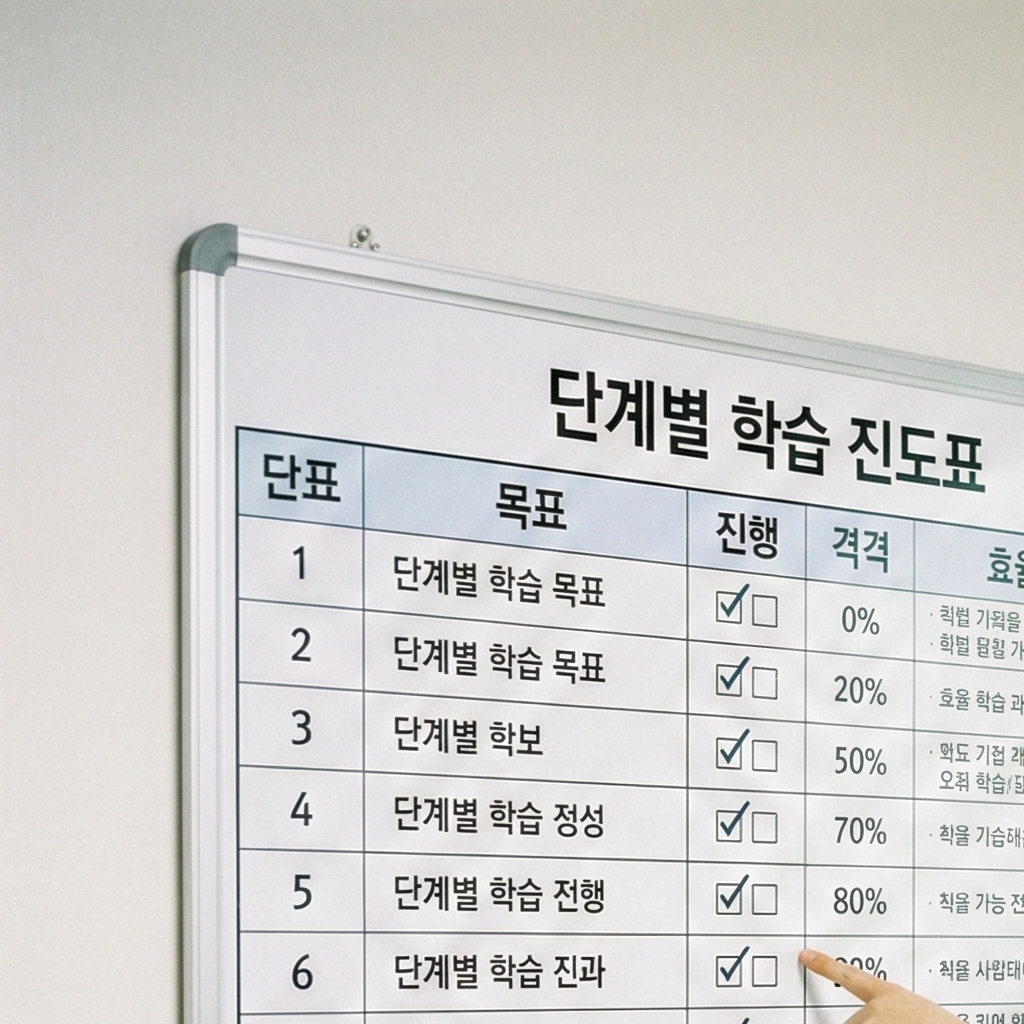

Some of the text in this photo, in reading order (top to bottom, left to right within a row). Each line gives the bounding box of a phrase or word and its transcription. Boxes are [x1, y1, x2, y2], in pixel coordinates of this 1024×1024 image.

[550, 367, 986, 493] 단계별 학습 진도표
[263, 453, 341, 503] 단표
[495, 482, 568, 531] 목표
[715, 512, 778, 560] 진행
[832, 526, 889, 574] 격격
[292, 545, 305, 580] 1
[393, 555, 606, 609] 단계별 학습 목표
[842, 606, 879, 635] 0%
[291, 627, 312, 663] 2
[394, 636, 606, 685] 단계별 학습 목표
[834, 674, 888, 706] 20%
[977, 690, 1005, 713] 학습
[291, 709, 312, 746] 3
[394, 716, 544, 757] 단계별 학보
[835, 747, 887, 775] 50%
[290, 791, 313, 827] 4
[394, 795, 604, 839] 단계별 학습 정성
[835, 817, 886, 844] 70%
[293, 873, 312, 910] 5
[394, 874, 605, 914] 단계별 학습 전행
[834, 887, 887, 914] 80%
[976, 894, 1006, 915] 가능
[291, 953, 314, 991] 6
[394, 954, 607, 991] 단계별 학습 진과
